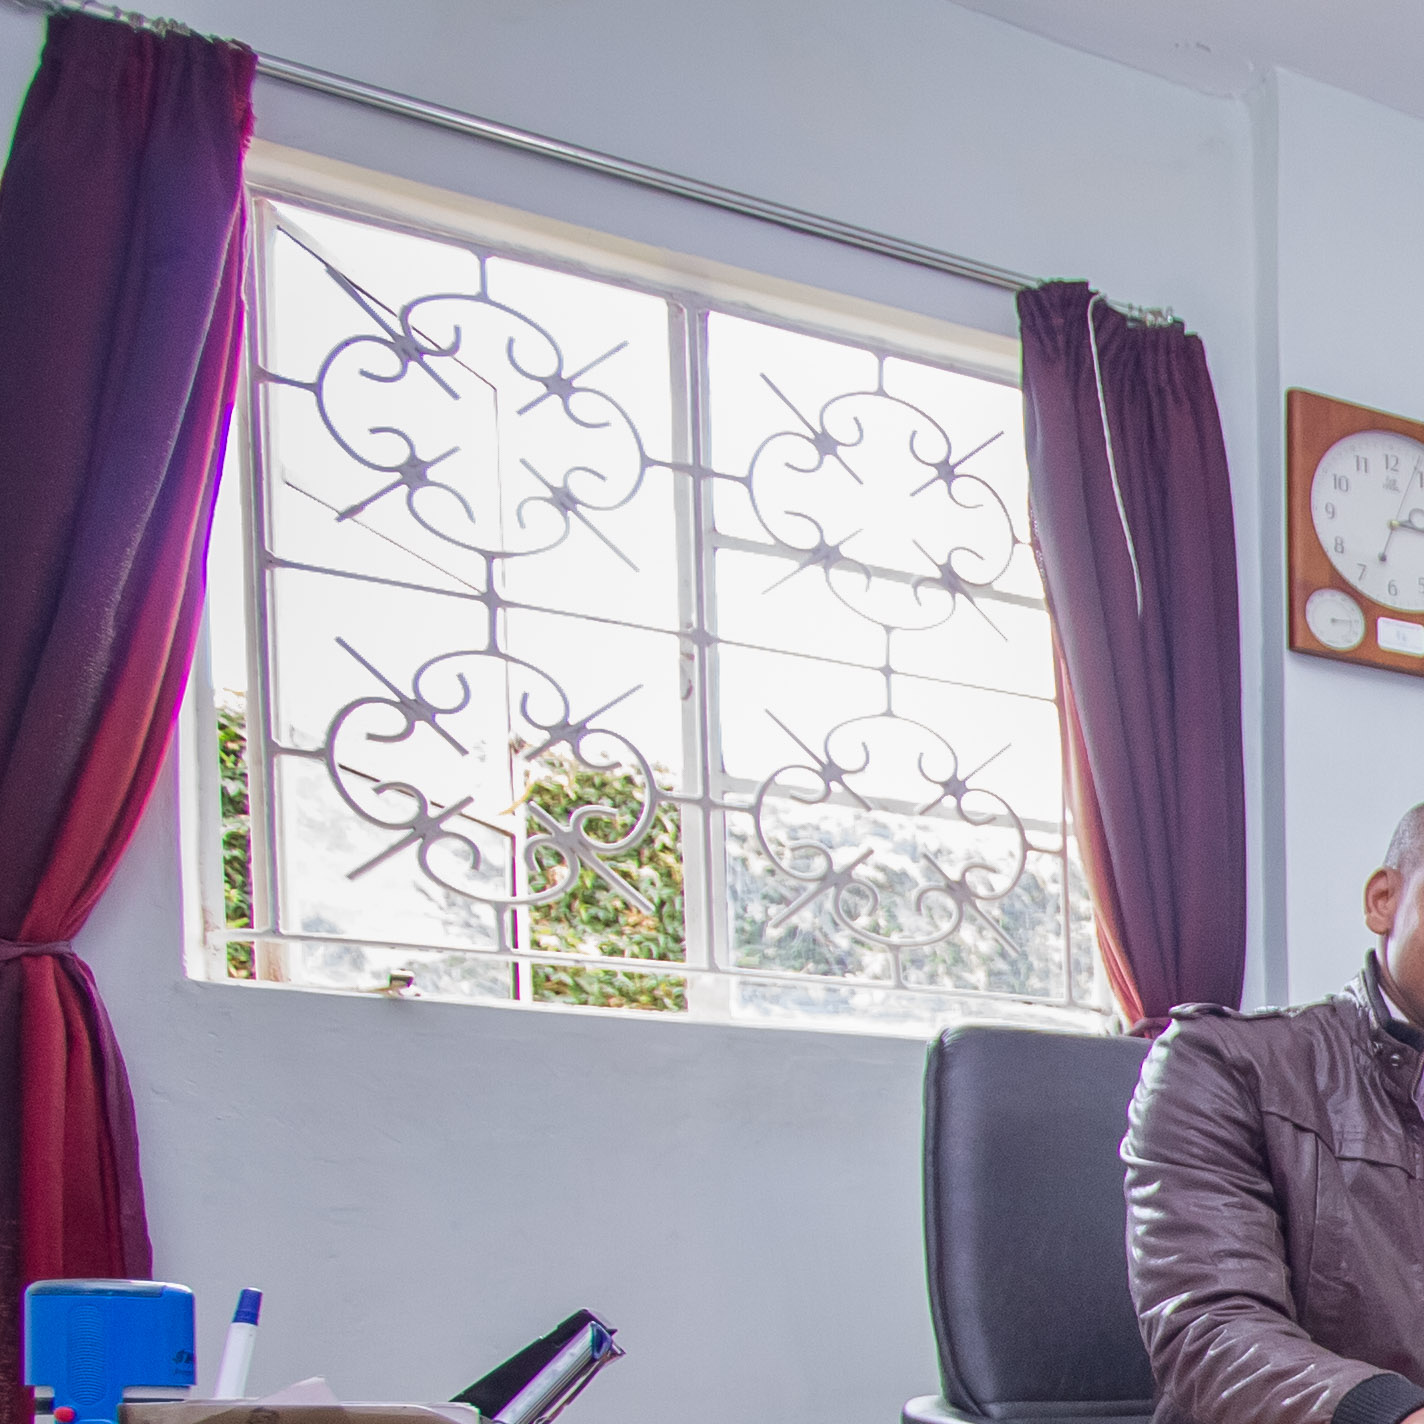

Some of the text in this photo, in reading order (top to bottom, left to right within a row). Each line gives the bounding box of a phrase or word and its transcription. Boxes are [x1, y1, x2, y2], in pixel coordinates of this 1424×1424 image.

[1355, 455, 1368, 474] 11
[1384, 454, 1399, 472] 12
[1333, 473, 1349, 493] 10
[1417, 470, 1424, 488] 1
[1325, 502, 1335, 519] 9
[1334, 536, 1345, 554] 8
[1357, 563, 1367, 581] 7
[1387, 579, 1398, 597] 6
